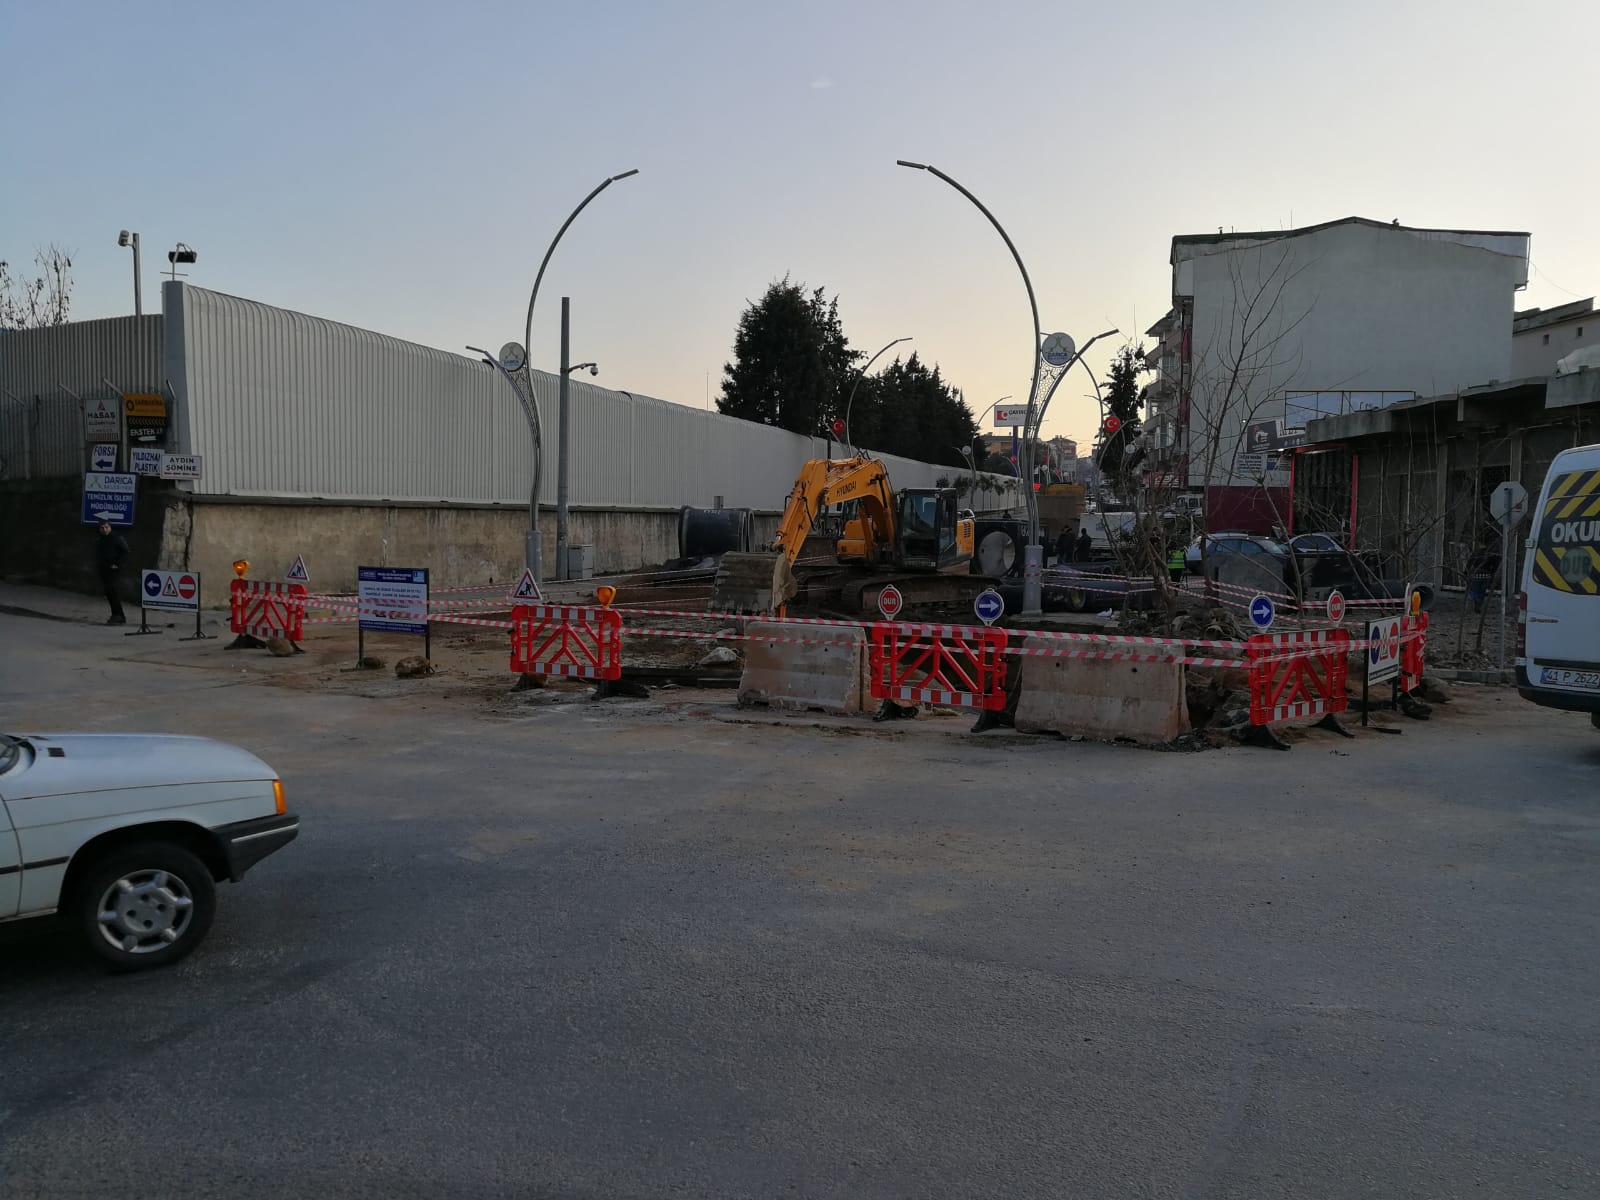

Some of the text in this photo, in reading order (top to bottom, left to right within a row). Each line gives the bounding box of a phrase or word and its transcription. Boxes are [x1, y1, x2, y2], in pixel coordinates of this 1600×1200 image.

[94, 446, 115, 456] FORSA
[104, 476, 133, 485] DARICA
[836, 480, 857, 496] HYUNDAI
[1562, 555, 1591, 577] DUR
[883, 597, 896, 605] DUR
[1545, 670, 1599, 685] 41 P 2622
